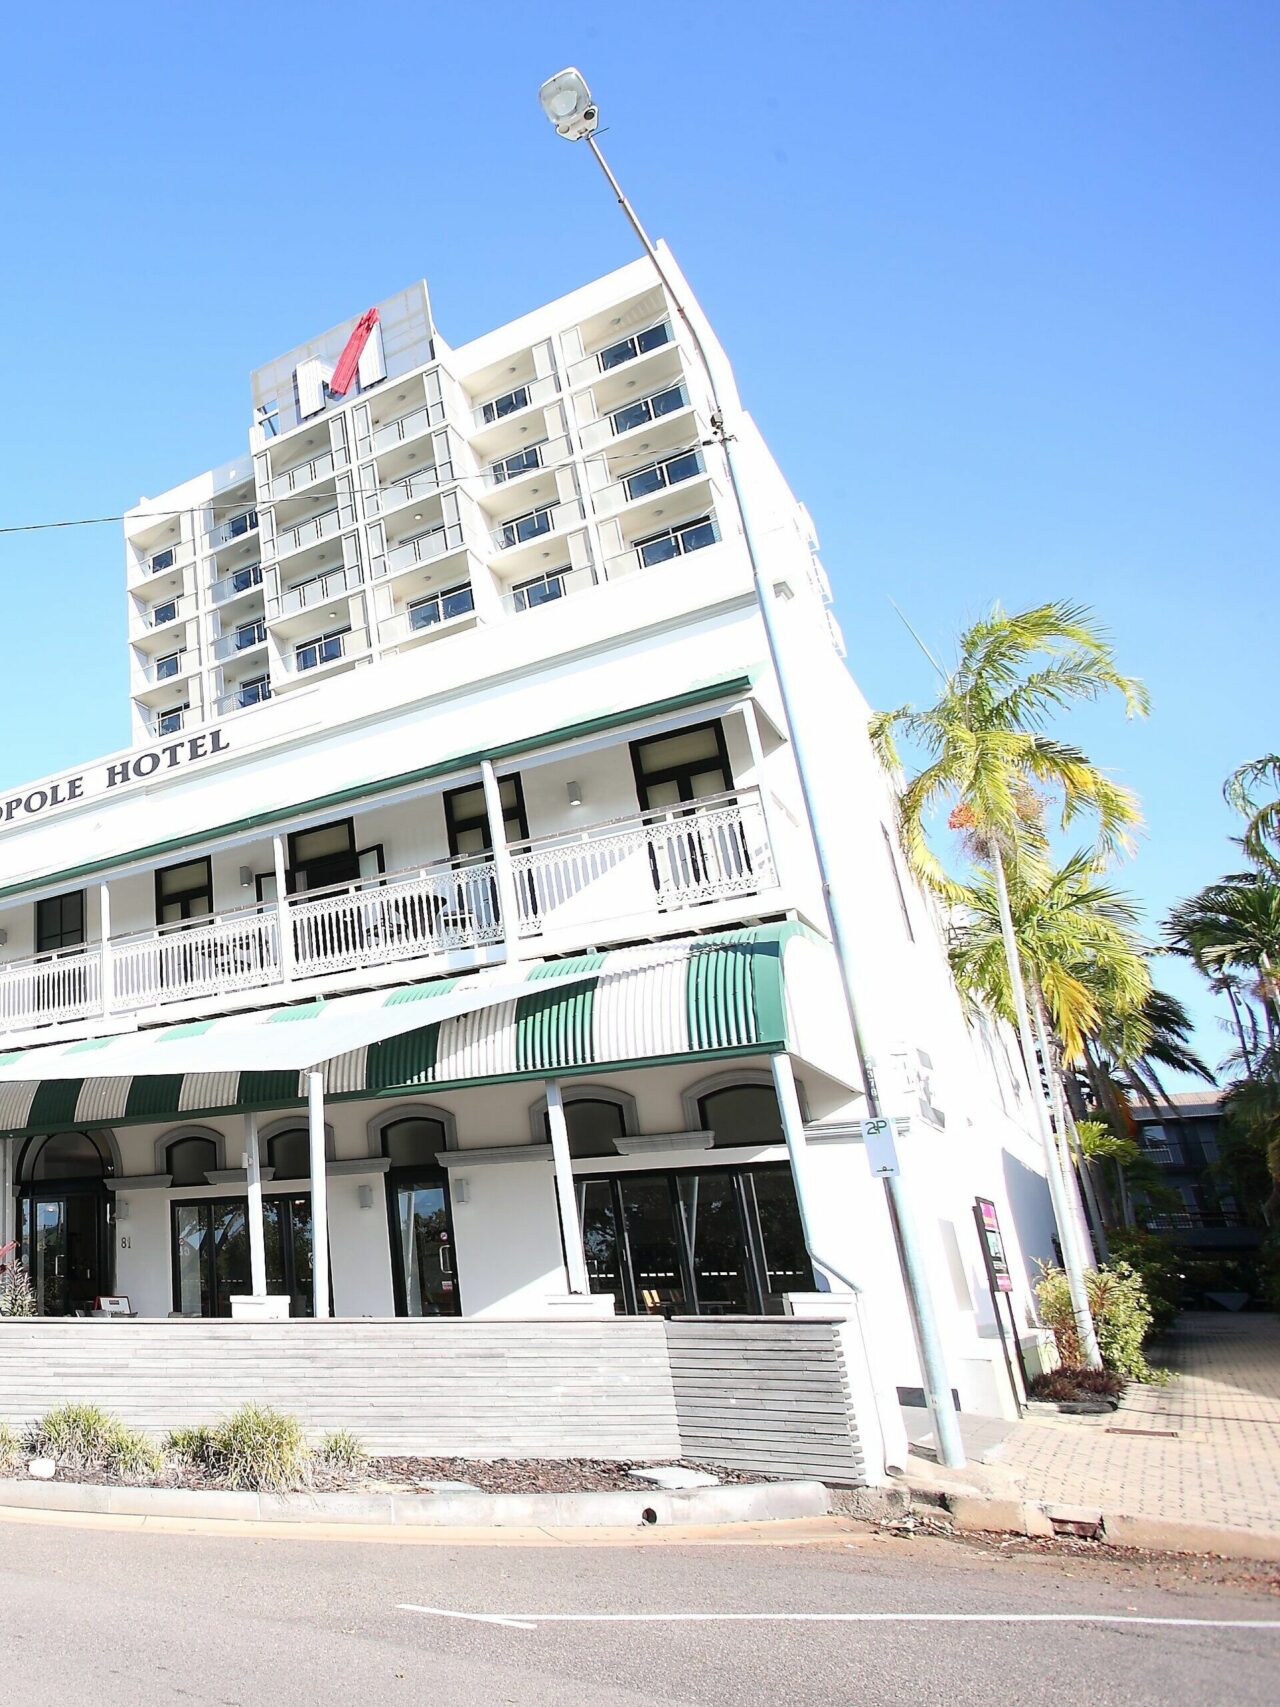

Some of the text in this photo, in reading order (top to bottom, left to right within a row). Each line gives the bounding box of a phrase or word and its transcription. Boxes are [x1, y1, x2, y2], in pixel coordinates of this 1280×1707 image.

[106, 729, 230, 788] HOTEL
[865, 1120, 887, 1135] 2P
[121, 1237, 132, 1249] 81
